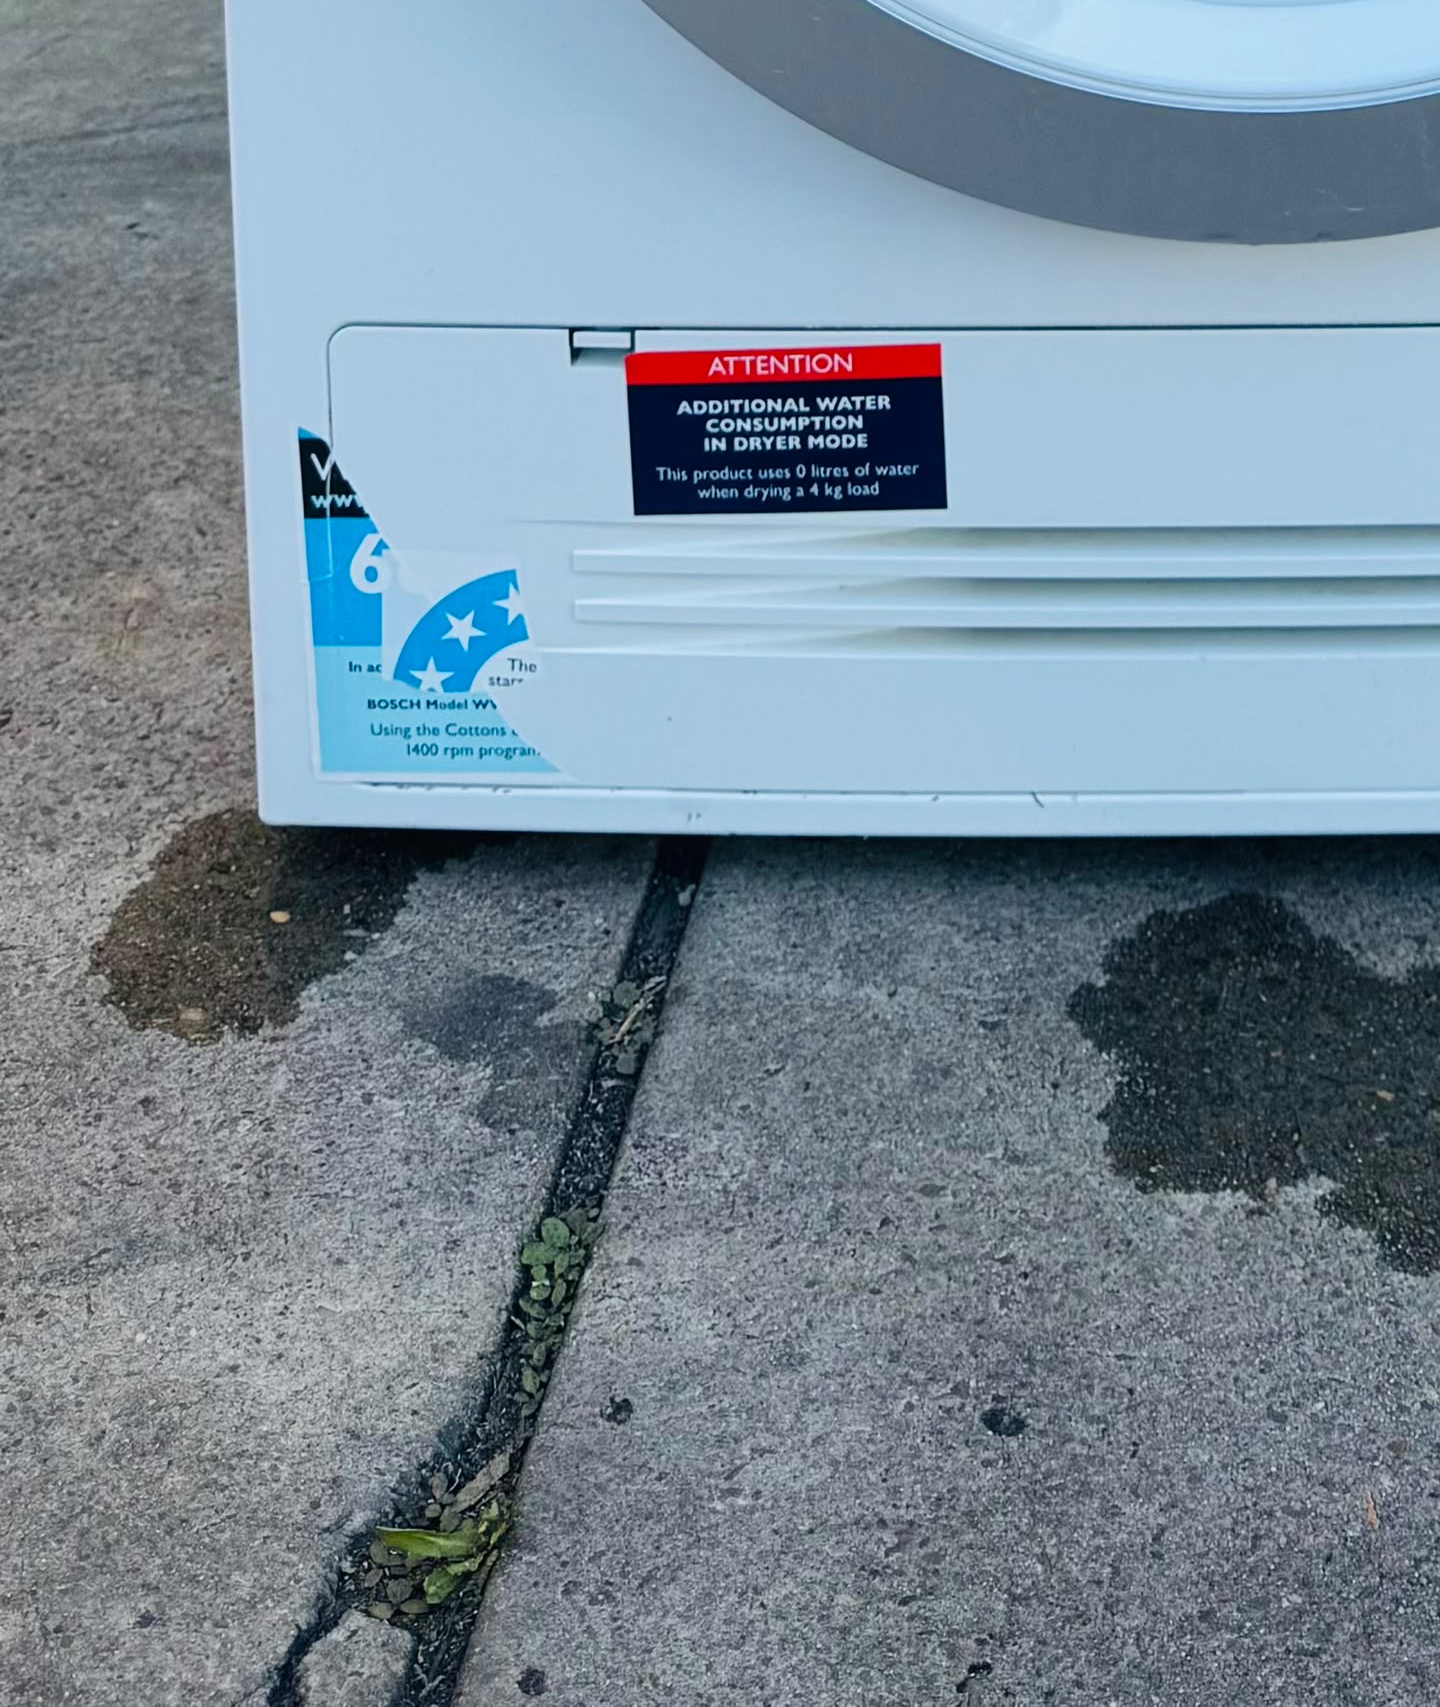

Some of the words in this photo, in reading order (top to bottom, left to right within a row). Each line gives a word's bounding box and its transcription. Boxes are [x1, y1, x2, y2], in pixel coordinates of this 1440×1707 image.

[707, 353, 853, 377] ATTENTION
[677, 396, 810, 416] ADDITIONAL
[816, 394, 891, 412] WATER
[705, 415, 864, 434] CONSUMPTION
[703, 436, 726, 452] IN
[733, 435, 801, 452] DRYER
[808, 433, 868, 450] MODE
[656, 465, 688, 483] This
[693, 464, 753, 484] product
[758, 466, 791, 480] uses
[796, 464, 806, 479] 0
[811, 463, 849, 479] litres
[854, 462, 871, 477] of
[875, 463, 919, 477] water
[697, 484, 739, 500] when
[744, 483, 791, 502] drying
[796, 485, 804, 497] a
[809, 483, 819, 497] 4
[824, 483, 843, 500] kg
[847, 481, 880, 496] load
[348, 661, 362, 673] In
[507, 658, 537, 673] The
[367, 699, 421, 710] BOSCH
[426, 698, 468, 710] Model
[370, 723, 412, 740] Using
[416, 723, 440, 737] the
[445, 723, 507, 737] Cottons
[407, 743, 439, 756] 1400
[444, 745, 474, 760] rpm
